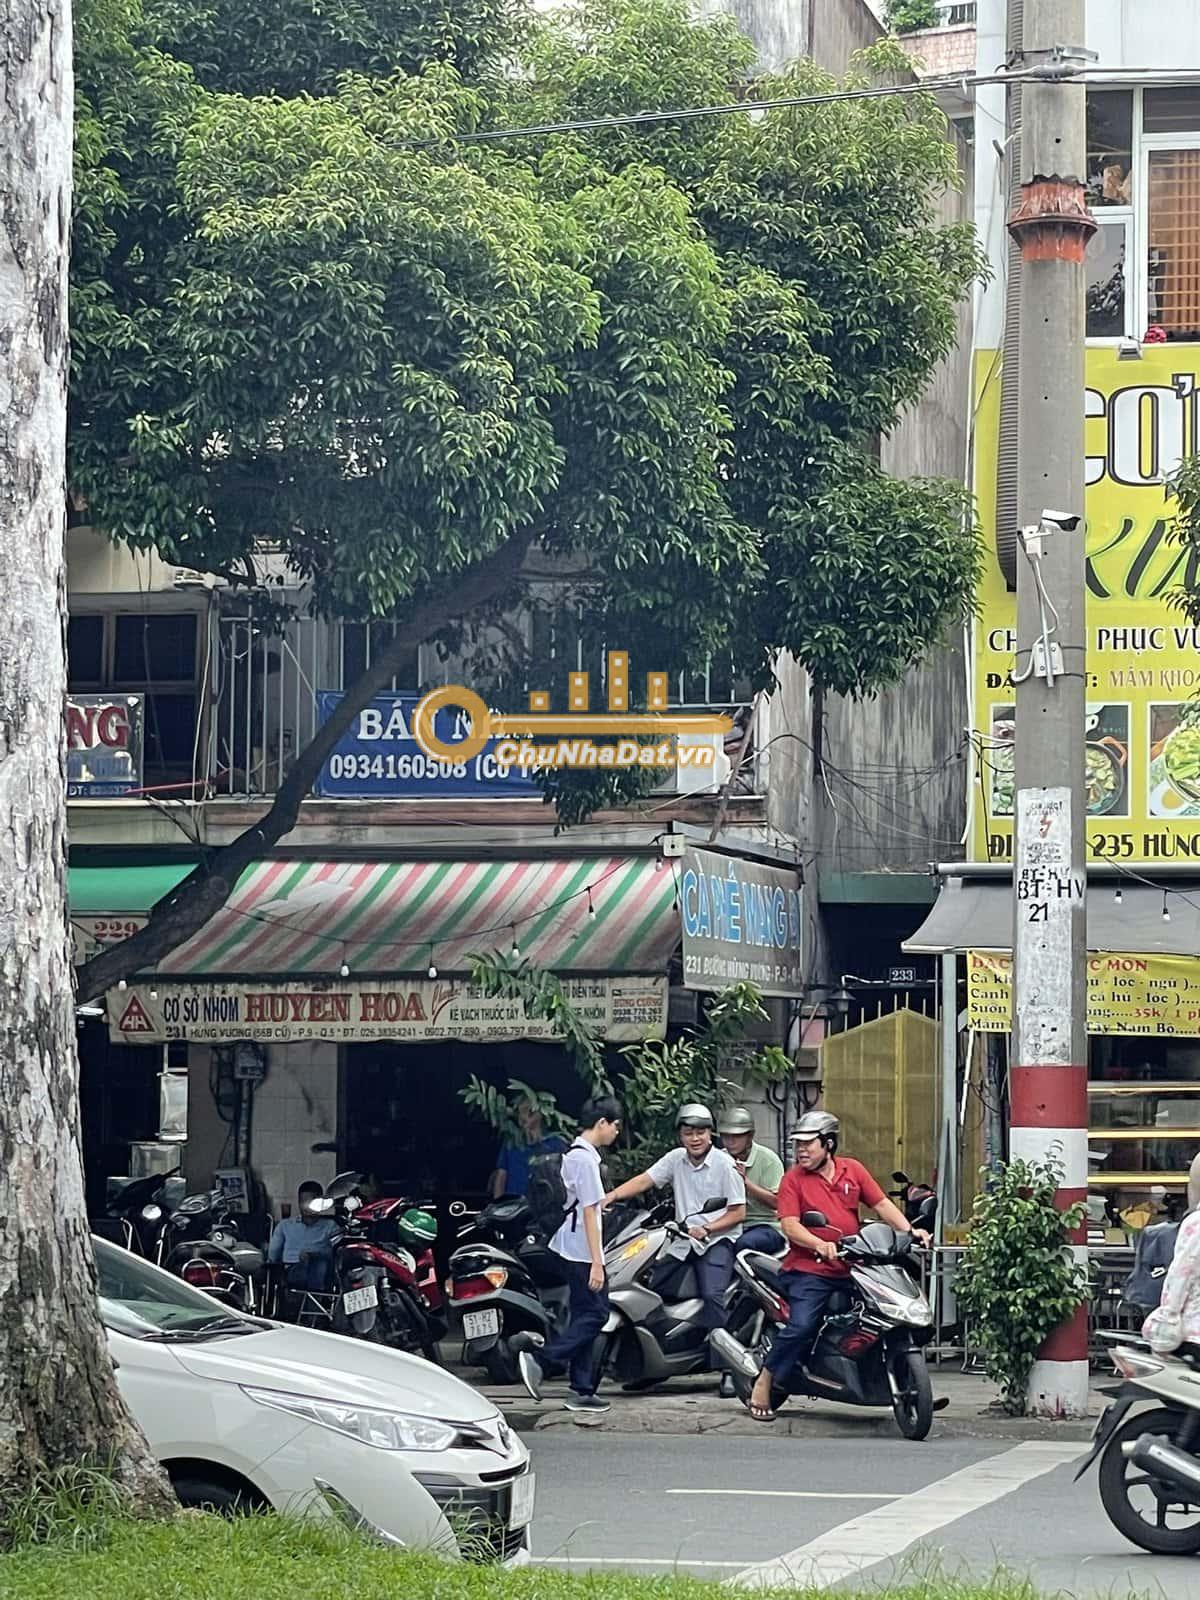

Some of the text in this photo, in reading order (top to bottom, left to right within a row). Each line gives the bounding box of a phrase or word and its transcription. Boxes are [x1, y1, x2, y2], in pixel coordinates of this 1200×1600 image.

[1096, 628, 1164, 655] PHỤC
[329, 754, 467, 779] 0934160508
[1092, 834, 1134, 857] 235
[1028, 902, 1049, 922] 21
[686, 955, 701, 974] 231
[892, 969, 914, 981] 233
[970, 988, 1009, 1000] Canh
[359, 991, 429, 1023] HOA
[165, 1025, 187, 1038] 231
